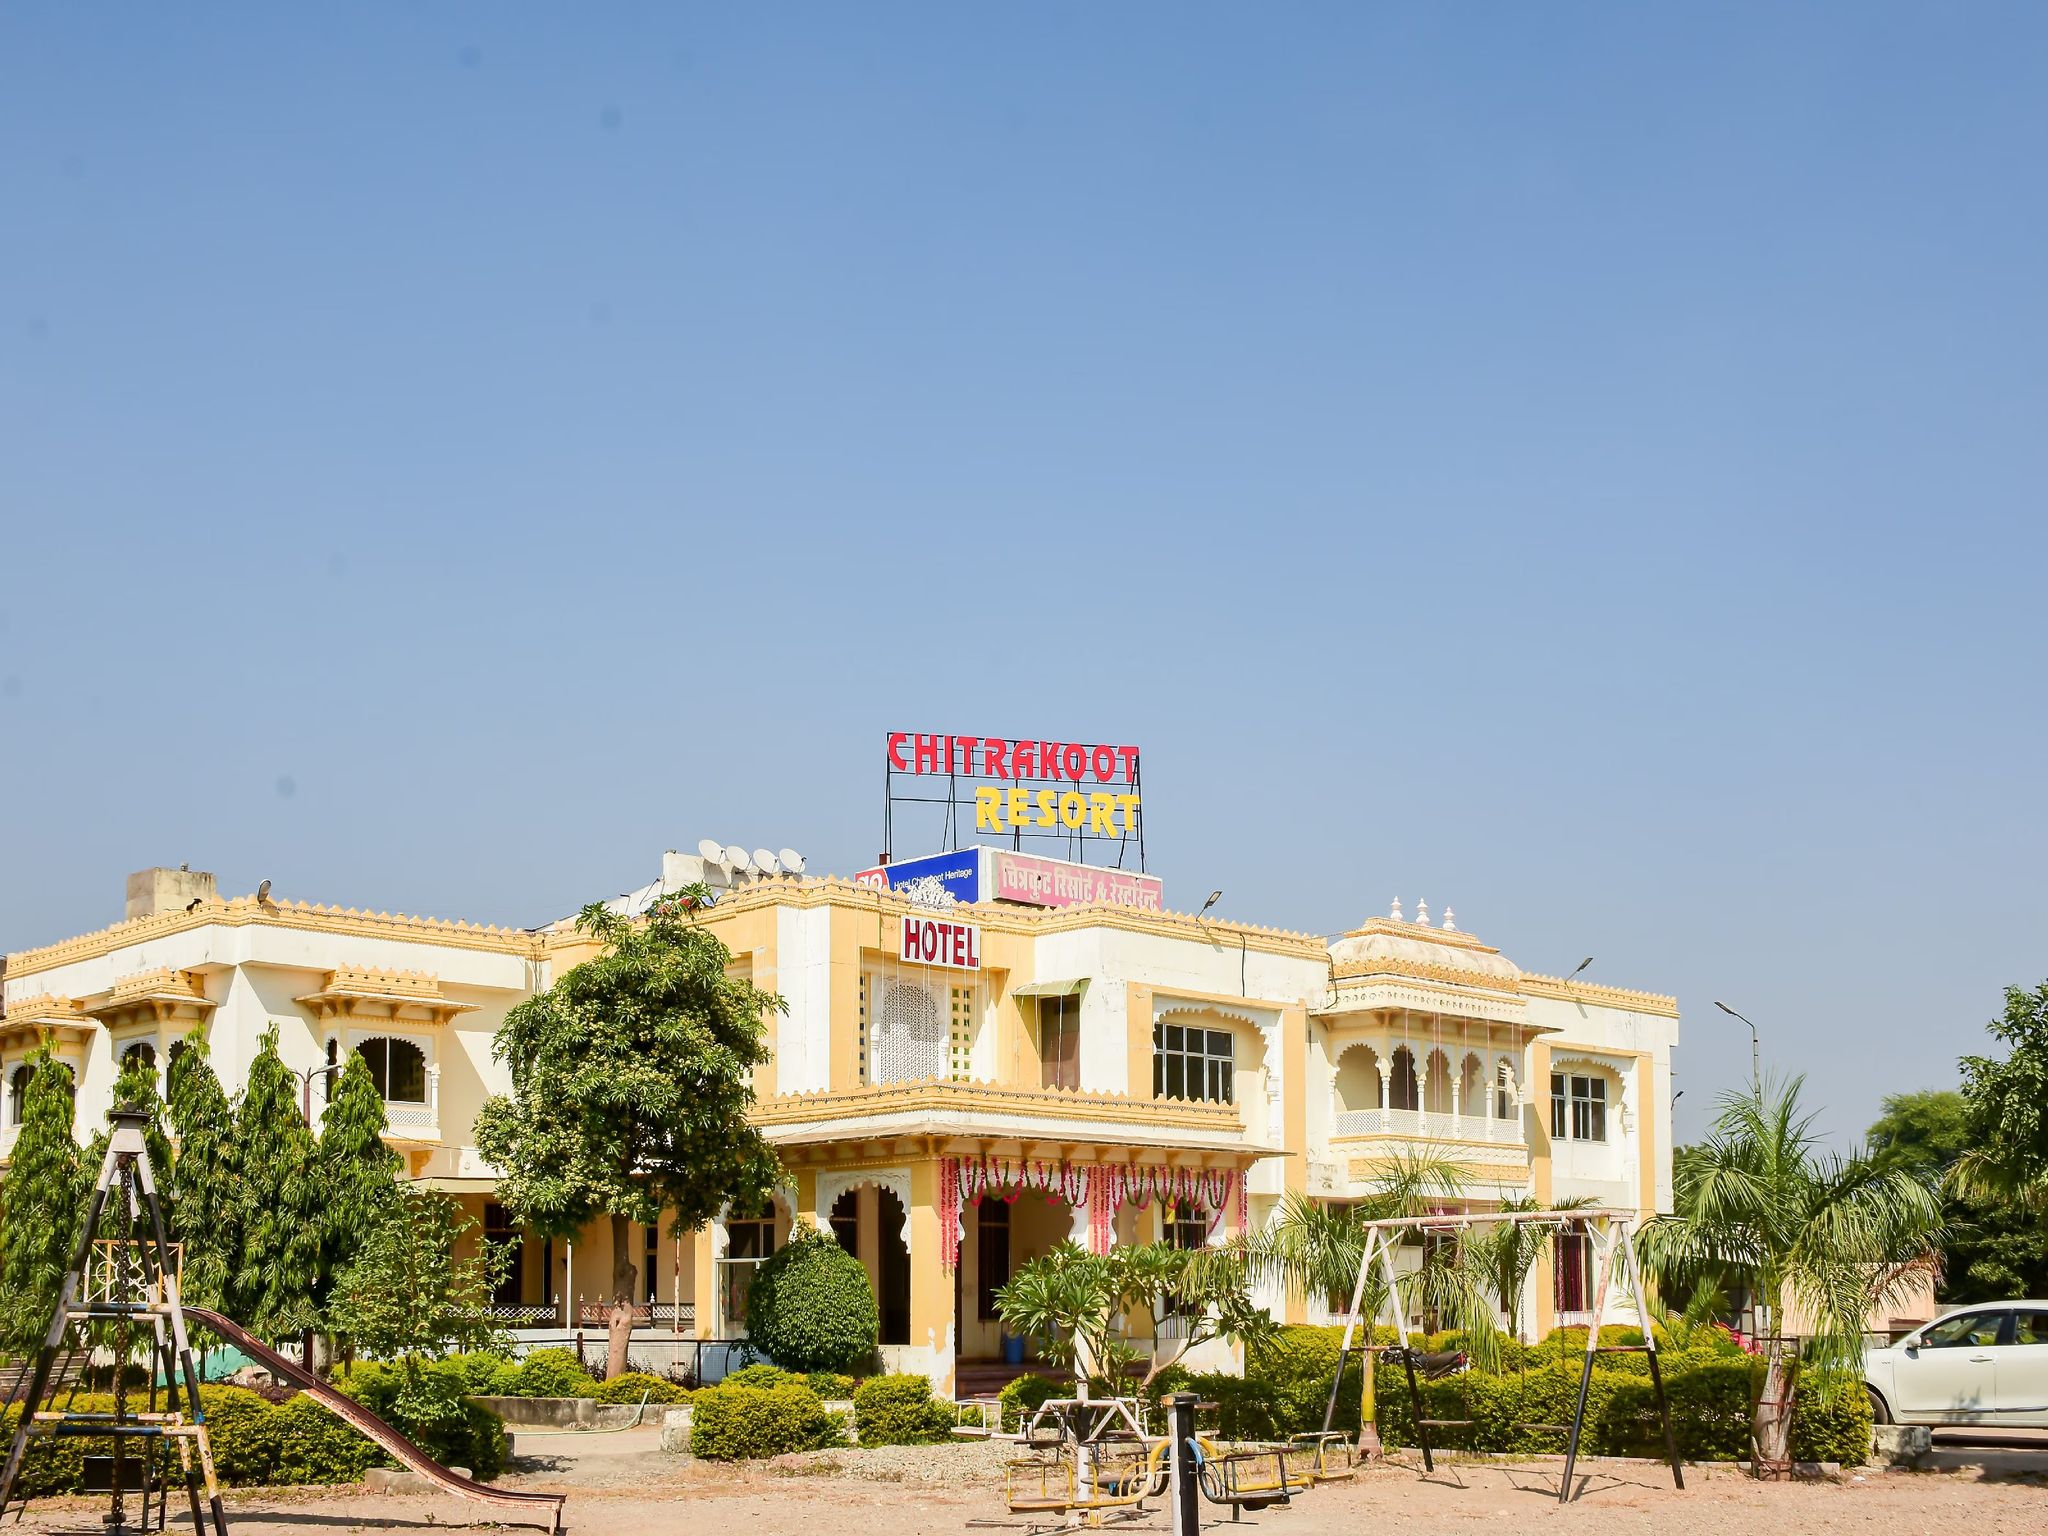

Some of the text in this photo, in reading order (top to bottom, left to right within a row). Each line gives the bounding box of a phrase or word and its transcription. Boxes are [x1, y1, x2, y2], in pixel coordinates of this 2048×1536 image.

[888, 732, 1139, 783] CHITRAKOOT
[976, 787, 1141, 839] RESORT
[894, 878, 911, 891] Hotel
[944, 868, 973, 880] Heritage
[904, 918, 979, 968] HOTEL
